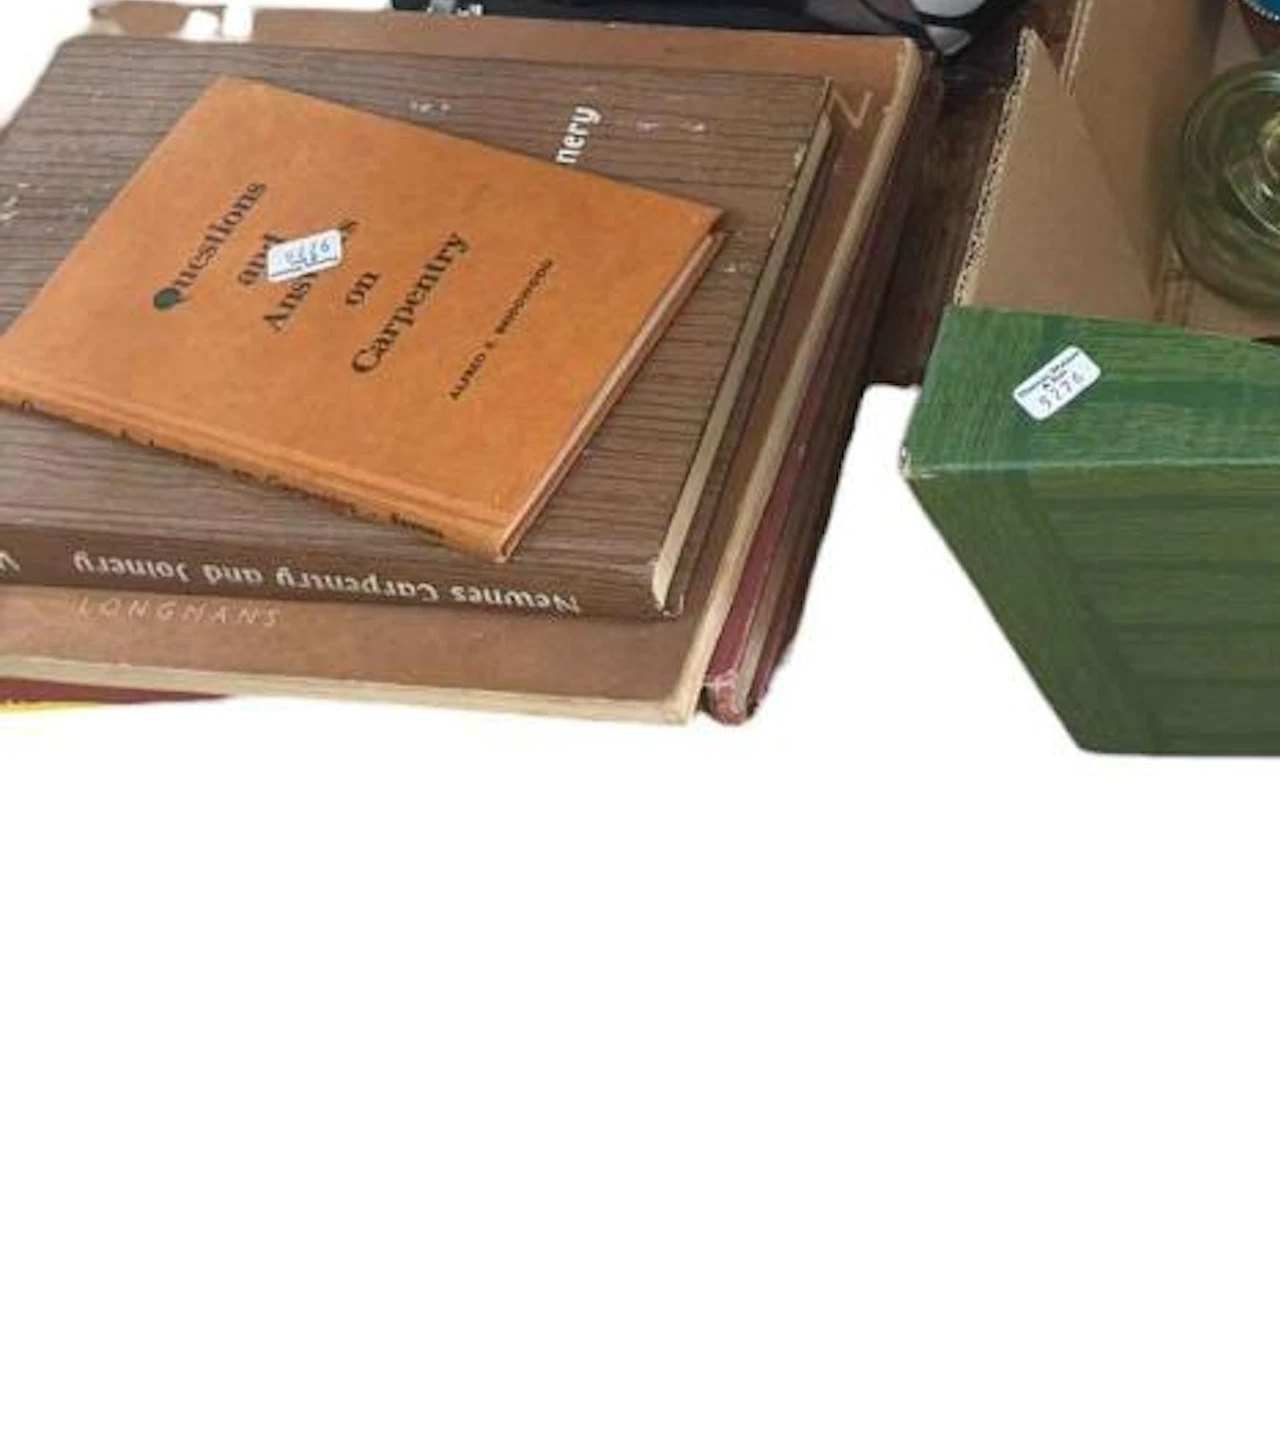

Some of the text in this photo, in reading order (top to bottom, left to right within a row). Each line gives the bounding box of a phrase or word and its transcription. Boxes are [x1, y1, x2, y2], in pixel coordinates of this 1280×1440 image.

[555, 105, 602, 164] nery
[152, 182, 267, 311] Questions
[345, 270, 381, 306] on
[351, 231, 471, 374] Carpentry
[73, 550, 581, 614] Newnes Carpentry and Joinery
[77, 596, 283, 628] LONGMANS
